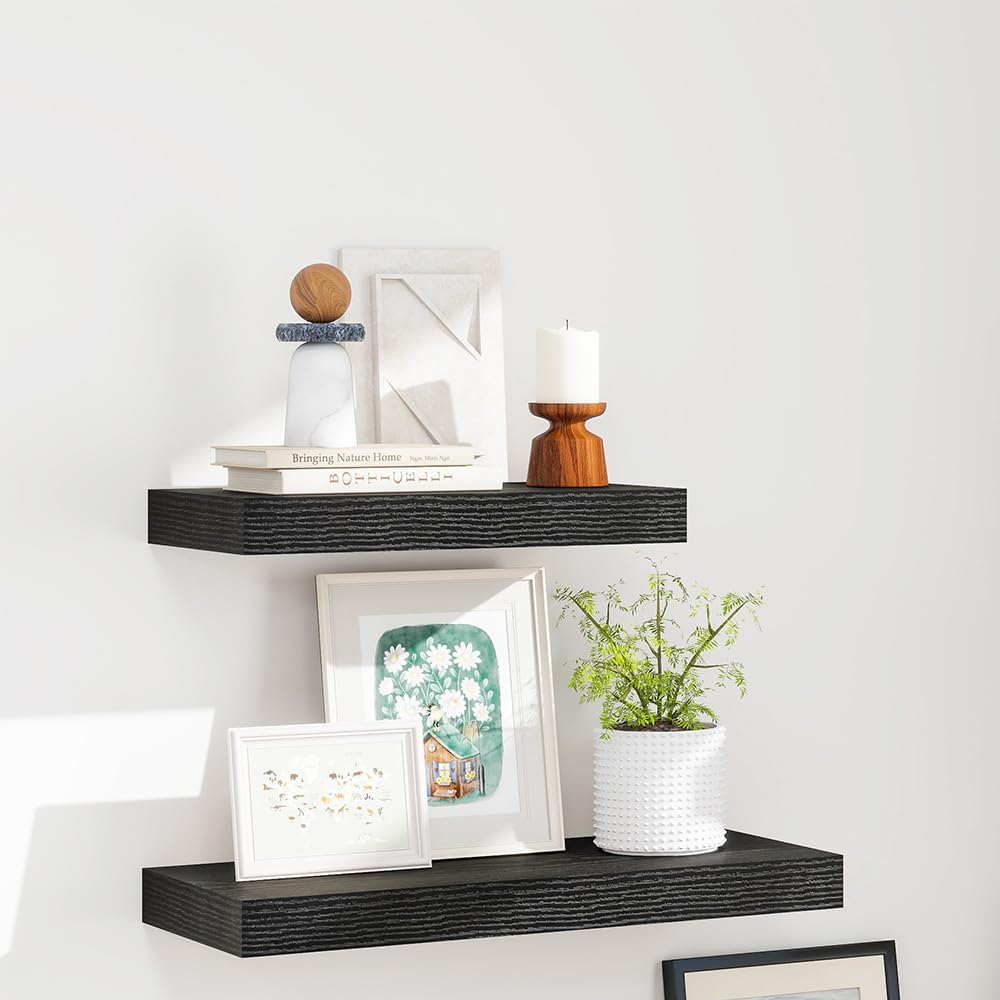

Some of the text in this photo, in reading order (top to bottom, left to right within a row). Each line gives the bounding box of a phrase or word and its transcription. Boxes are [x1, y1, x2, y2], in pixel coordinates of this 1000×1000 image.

[292, 452, 402, 465] Bringing Nature Home
[329, 471, 453, 486] BOTTICELLI
